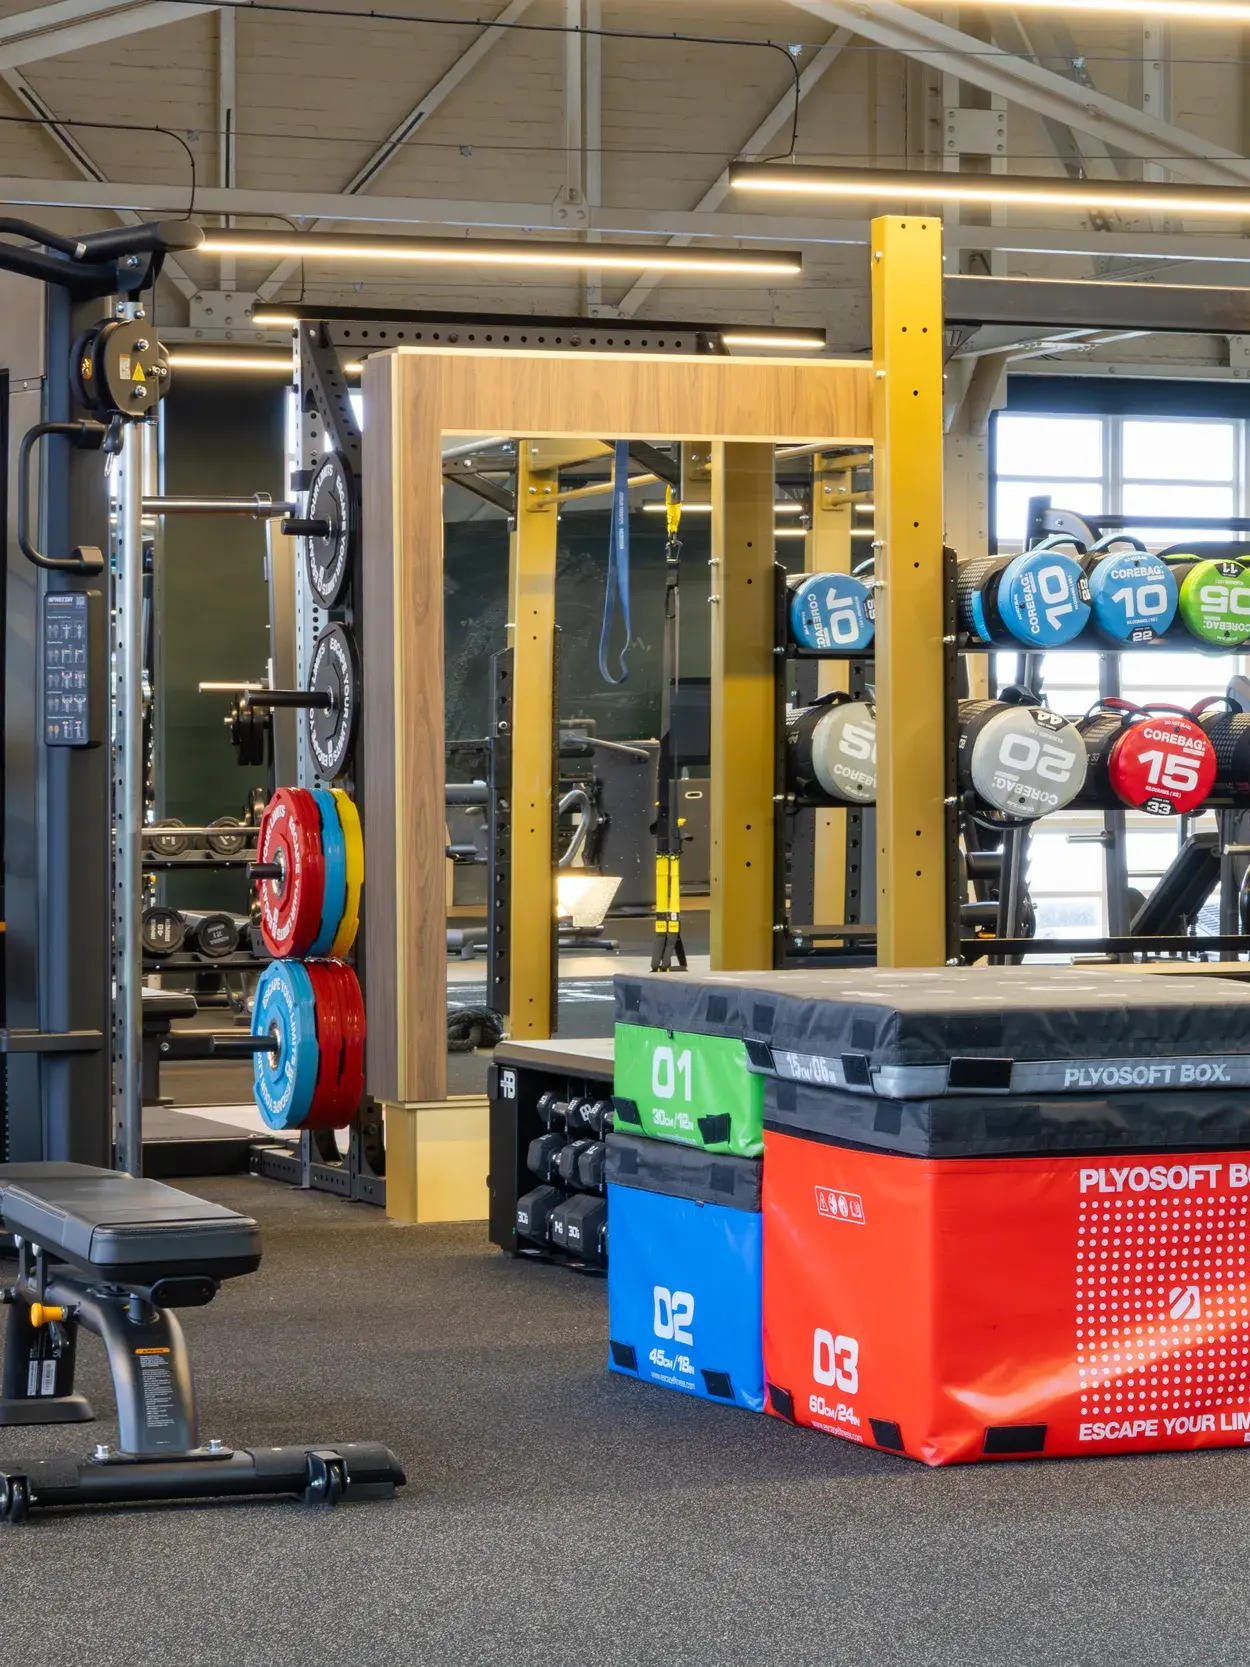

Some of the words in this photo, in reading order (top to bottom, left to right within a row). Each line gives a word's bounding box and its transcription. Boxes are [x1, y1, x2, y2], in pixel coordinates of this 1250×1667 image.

[1222, 562, 1238, 574] 11
[1038, 565, 1072, 631] 10
[1111, 584, 1168, 618] 10
[1132, 630, 1152, 642] 22
[310, 640, 325, 683] LIMITS
[329, 636, 346, 676] ESCAPE
[1036, 710, 1063, 725] 44
[310, 728, 327, 767] ESCAPE
[332, 719, 347, 763] LIMITS
[998, 733, 1076, 784] 20
[1138, 750, 1201, 792] 15
[1146, 801, 1171, 815] 33
[652, 1046, 692, 1102] 01
[1064, 1065, 1176, 1088] PLYOSOFT
[1180, 1064, 1231, 1083] BOX.
[1080, 1164, 1222, 1194] PLYOSOFT
[654, 1286, 694, 1346] 02
[813, 1328, 858, 1394] 03
[1079, 1418, 1158, 1441] ESCAPE
[1163, 1414, 1215, 1436] YOUR
